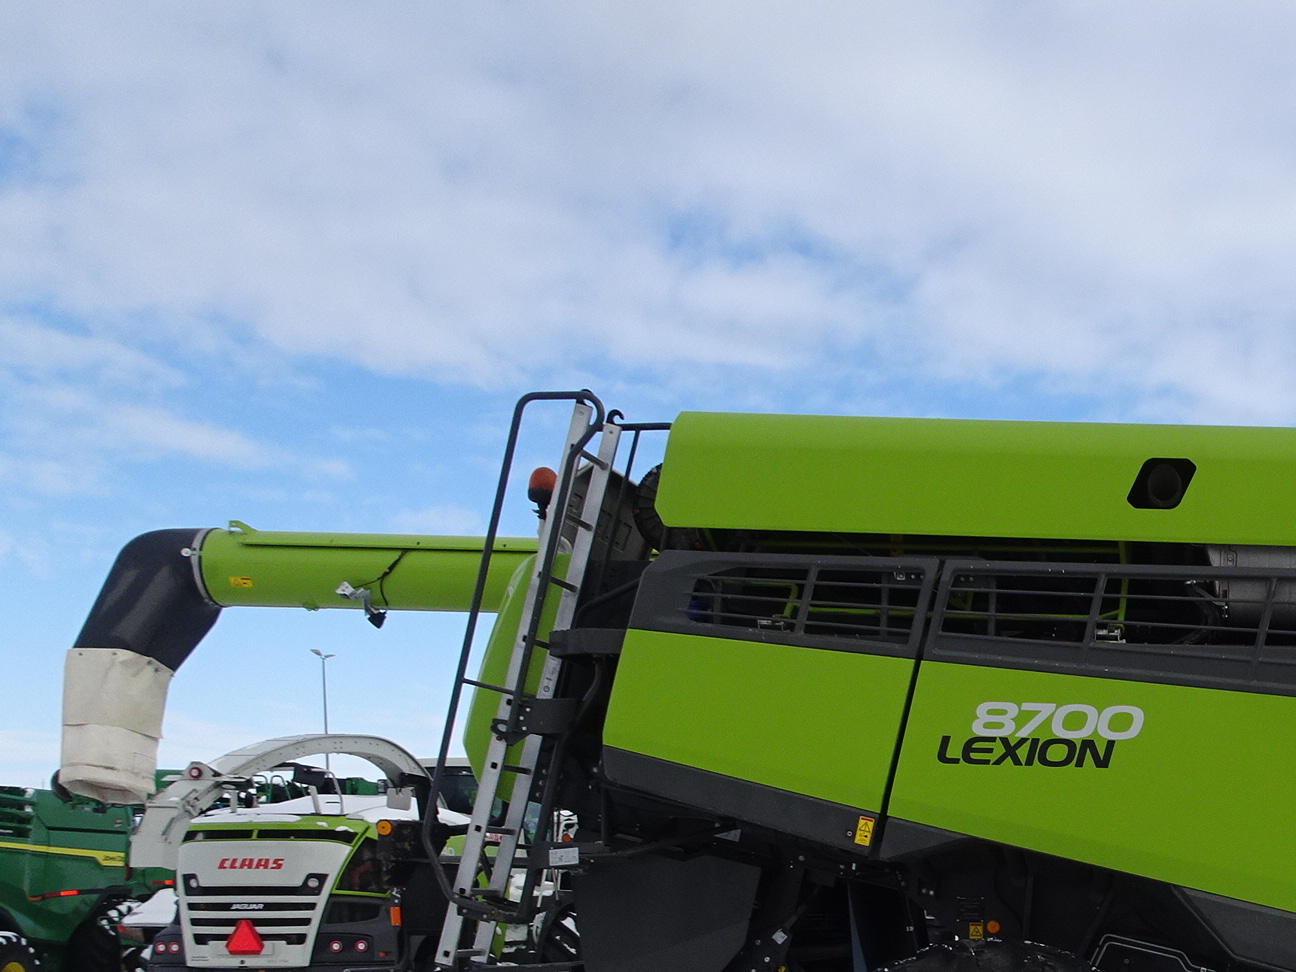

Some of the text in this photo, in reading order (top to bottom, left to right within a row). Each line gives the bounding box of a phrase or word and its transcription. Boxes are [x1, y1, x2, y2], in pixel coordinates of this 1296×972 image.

[972, 701, 1144, 740] 8700
[937, 735, 1116, 769] LEXION
[217, 858, 285, 870] CLAAS
